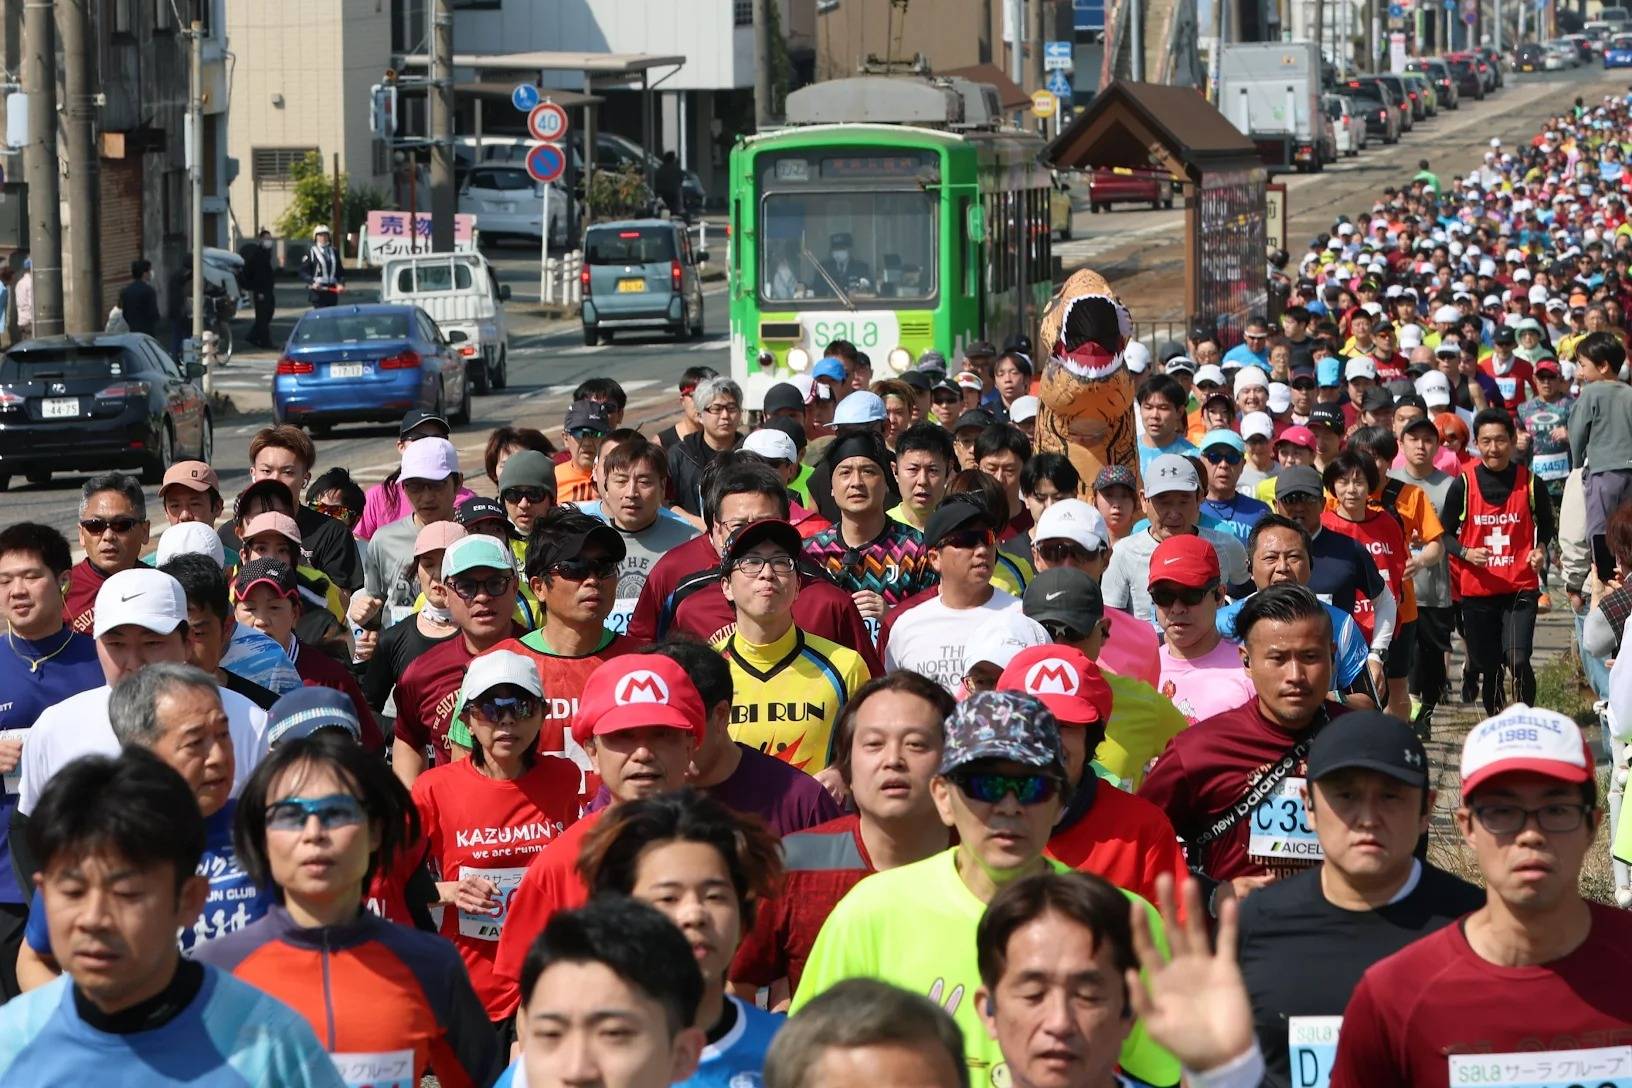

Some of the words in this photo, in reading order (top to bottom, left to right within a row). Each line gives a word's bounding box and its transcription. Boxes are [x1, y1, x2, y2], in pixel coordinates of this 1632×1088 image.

[537, 113, 559, 130] 40
[1473, 513, 1521, 526] MEDICAL
[621, 675, 666, 702] M
[1030, 664, 1075, 693] M
[767, 702, 826, 722] RUN
[1211, 812, 1236, 836] new
[1234, 757, 1294, 817] balance
[1256, 799, 1274, 831] C
[472, 850, 490, 860] we
[491, 847, 512, 858] are
[226, 886, 256, 900] CLUB
[1299, 1049, 1319, 1087] D
[1459, 1064, 1501, 1083] sala
